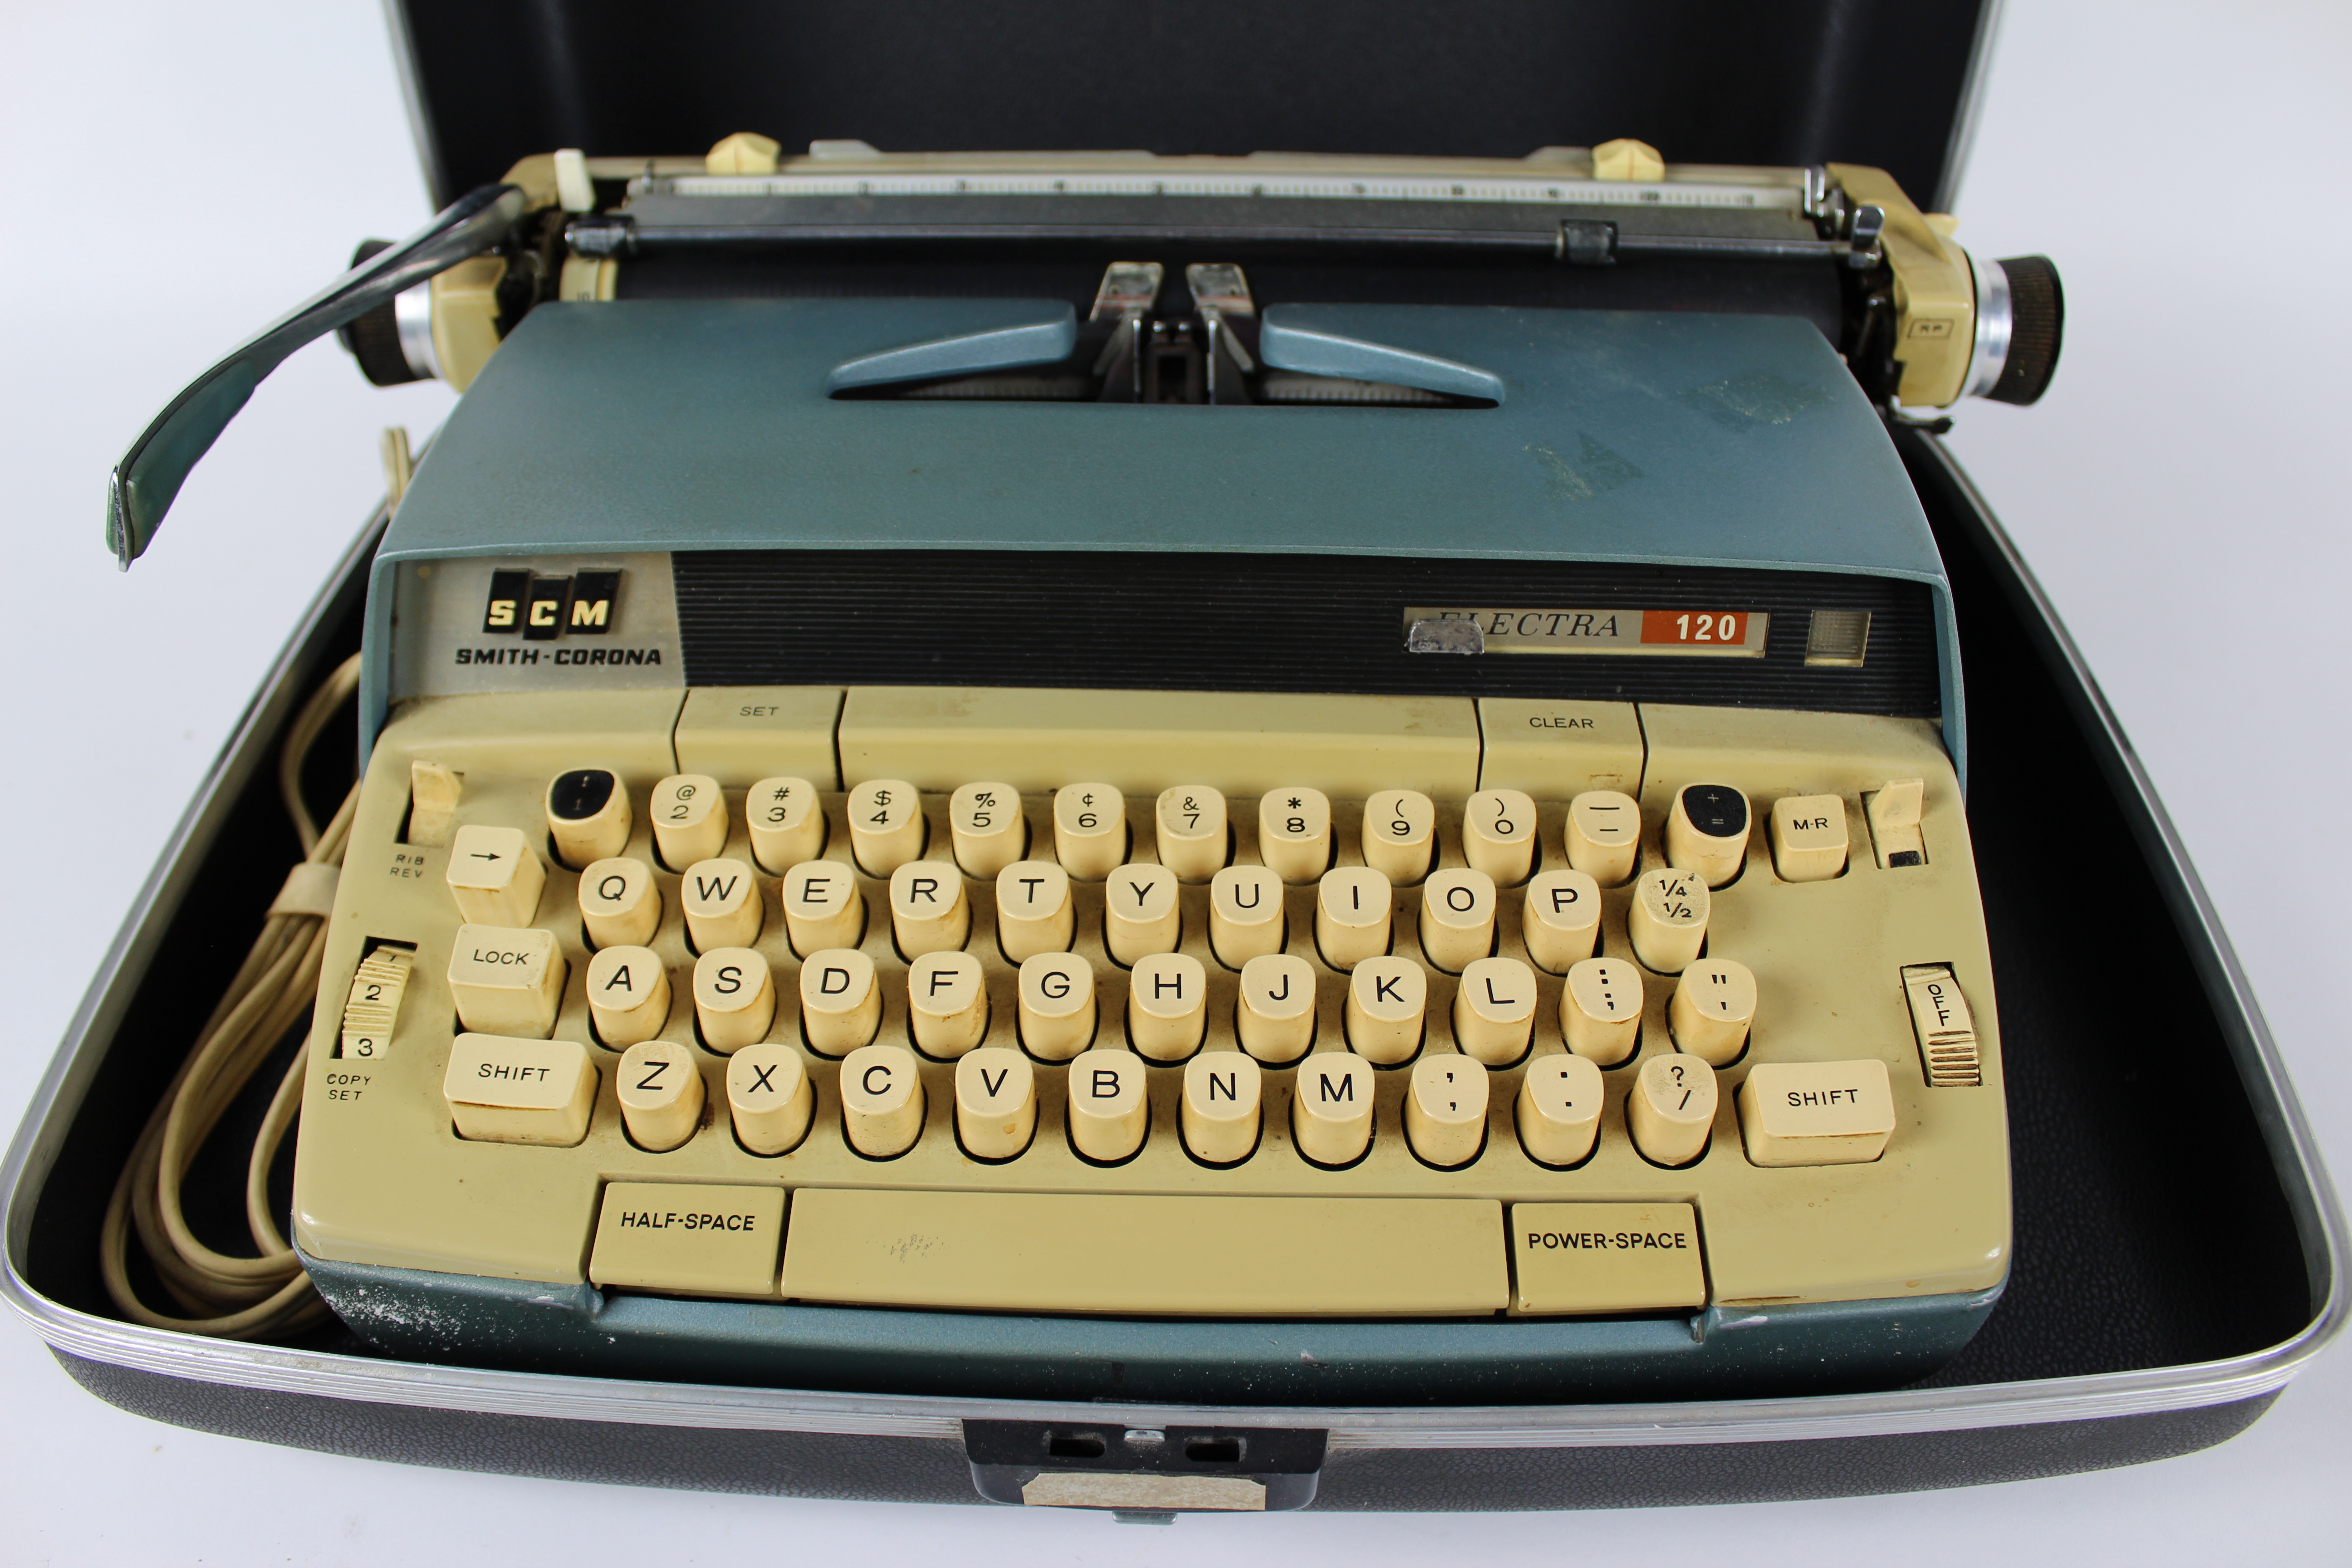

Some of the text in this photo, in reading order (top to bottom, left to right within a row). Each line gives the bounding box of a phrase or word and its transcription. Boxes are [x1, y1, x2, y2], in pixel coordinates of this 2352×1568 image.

[487, 599, 611, 627] SCM
[1676, 614, 1736, 641] 120
[456, 648, 662, 665] SMITH-CORONA
[739, 706, 780, 717] SET
[1529, 717, 1593, 729] CLEAR
[676, 784, 696, 801] @
[774, 787, 790, 801] #
[874, 790, 892, 807] $
[975, 792, 996, 808] %
[1082, 793, 1093, 807] ¢
[670, 805, 689, 819] 2
[1183, 796, 1199, 811] &
[1395, 798, 1405, 818] (
[1494, 797, 1505, 818] )
[767, 807, 786, 822] 3
[870, 810, 889, 825] 4
[972, 812, 991, 828] 5
[1078, 813, 1097, 828] 6
[1183, 813, 1200, 829] 7
[1286, 817, 1305, 833] 8
[1793, 818, 1828, 830] M-R
[1391, 820, 1410, 836] 9
[396, 854, 424, 865] RIB
[390, 867, 422, 878] REV
[598, 875, 626, 901] Q
[696, 876, 737, 901] W
[802, 878, 831, 903] E
[910, 878, 938, 903] R
[1019, 878, 1045, 903] T
[1129, 882, 1155, 906] Y
[1235, 883, 1259, 909] U
[1352, 885, 1360, 911] I
[1447, 887, 1475, 912] O
[1551, 888, 1578, 913] P
[473, 949, 529, 965] LOCK
[605, 965, 632, 992] A
[714, 966, 742, 994] S
[820, 967, 850, 994] D
[930, 970, 959, 996] F
[1041, 971, 1070, 999] G
[1154, 973, 1181, 999] H
[1269, 974, 1289, 1001] J
[1376, 976, 1405, 1002] K
[365, 984, 381, 1001] 2
[1485, 978, 1515, 1004] L
[1927, 984, 1950, 1027] OFF
[358, 1038, 373, 1057] 3
[327, 1073, 371, 1085] COPY
[478, 1063, 550, 1082] SHIFT
[636, 1061, 670, 1090] Z
[747, 1064, 778, 1093] X
[862, 1065, 892, 1095] C
[980, 1068, 1008, 1098] V
[1671, 1066, 1684, 1087] ?
[1092, 1070, 1120, 1098] B
[1210, 1073, 1236, 1101] N
[1320, 1073, 1353, 1102] M
[328, 1089, 362, 1101] SET
[1678, 1089, 1691, 1110] /
[1788, 1089, 1858, 1107] SHIFT
[621, 1212, 755, 1231] HALF-SPACE
[1528, 1233, 1687, 1249] POWER-SPACE
